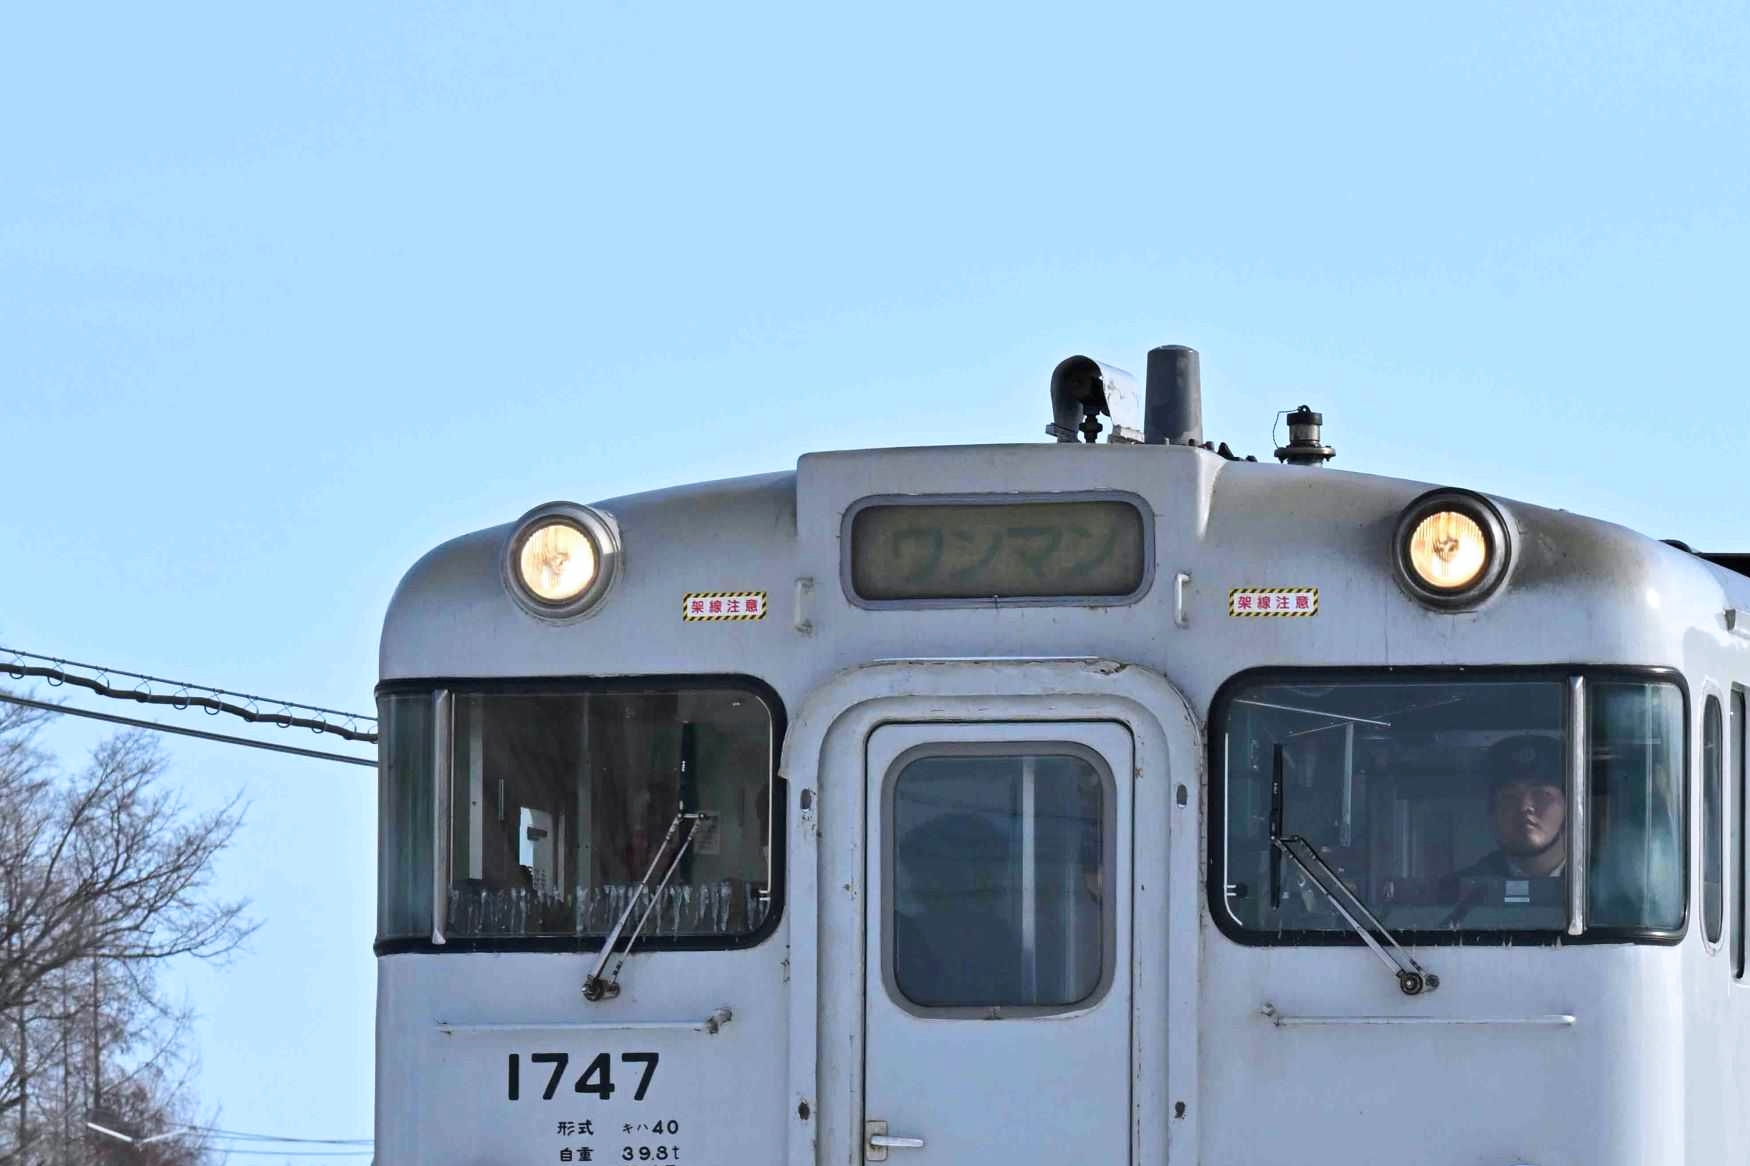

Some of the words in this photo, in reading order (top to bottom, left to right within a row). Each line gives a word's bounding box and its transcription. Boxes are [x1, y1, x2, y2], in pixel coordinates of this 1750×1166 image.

[893, 525, 1119, 584] ワンマン
[691, 599, 758, 614] 架線注意
[1238, 595, 1309, 610] 架線注意
[508, 1052, 660, 1101] 1747
[557, 1119, 594, 1136] 形式
[560, 1146, 594, 1162] 自重
